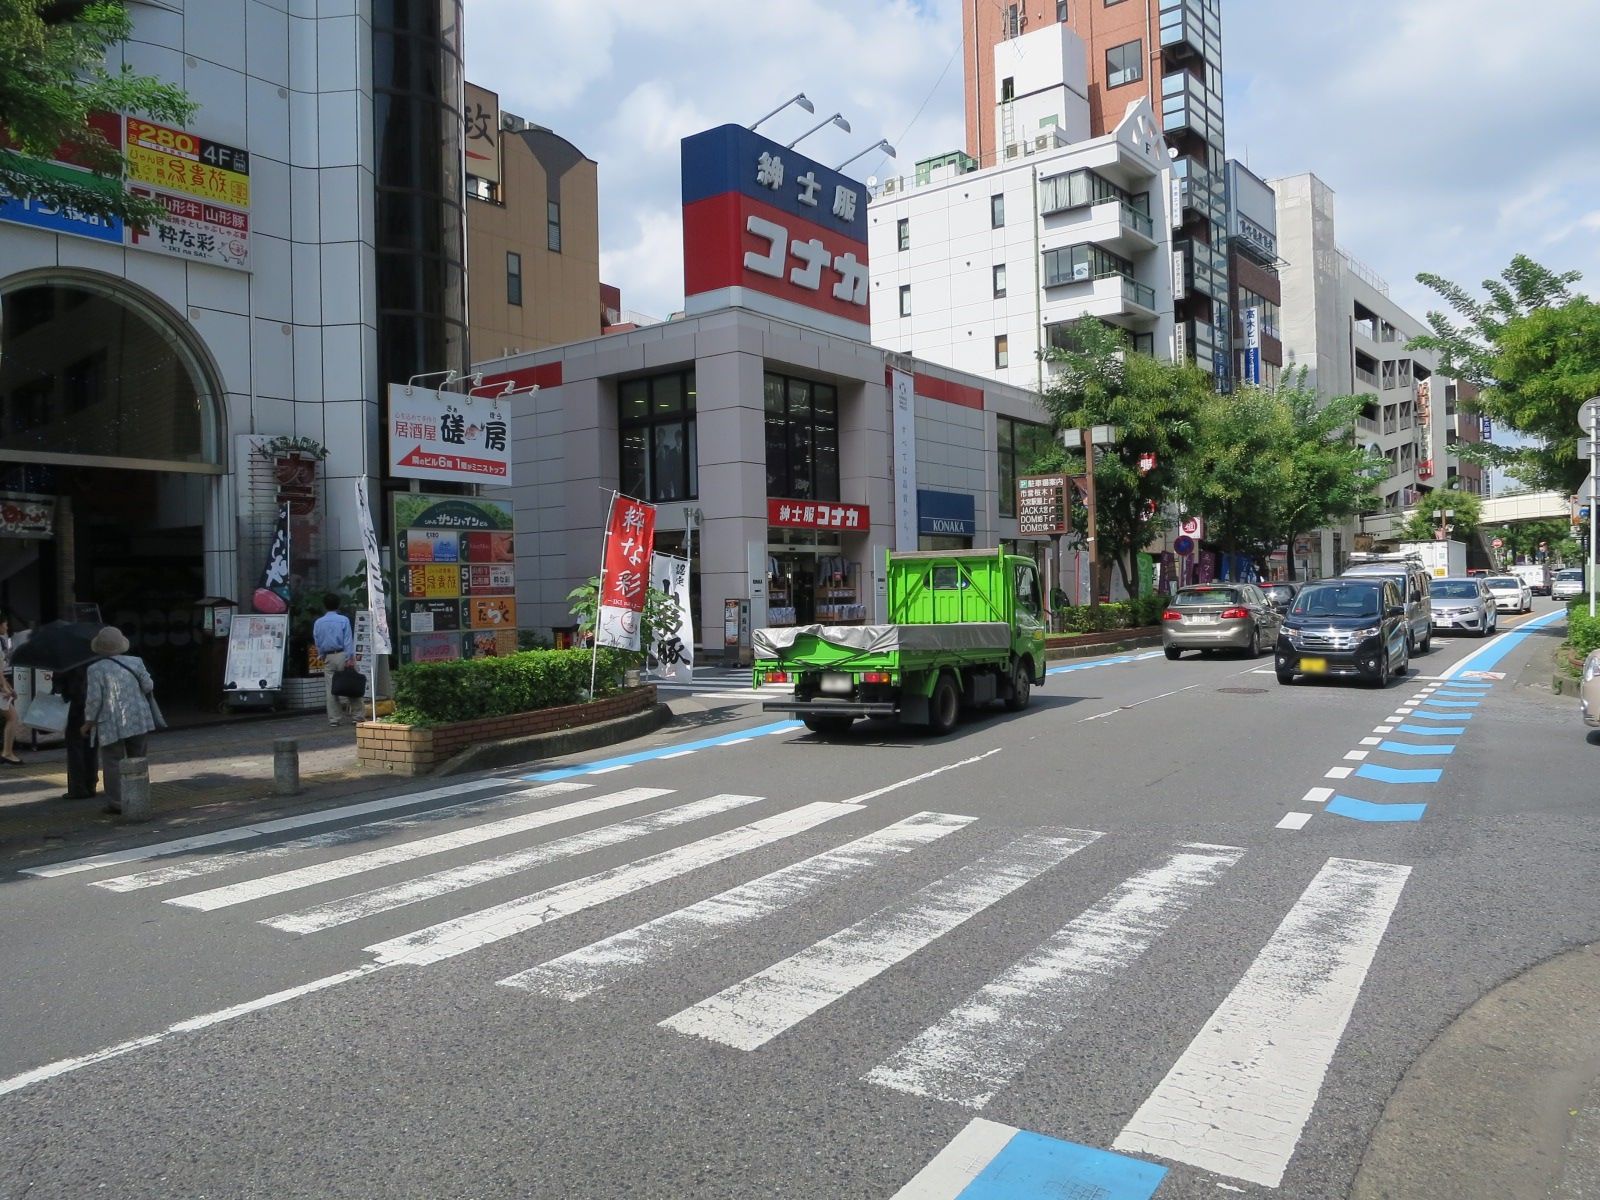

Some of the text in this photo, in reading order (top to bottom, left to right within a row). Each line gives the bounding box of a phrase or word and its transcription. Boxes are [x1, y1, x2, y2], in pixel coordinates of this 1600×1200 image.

[204, 145, 231, 166] 4F
[757, 151, 858, 222] 紳士服
[205, 208, 246, 229] 山形豚
[159, 225, 214, 252] 粋な彩
[743, 215, 869, 306] コナカ
[394, 420, 436, 441] 居酒屋
[779, 505, 859, 526] 紳士服 コナカ
[1020, 506, 1049, 515] JACK大宮
[933, 520, 965, 533] KONAKA
[614, 505, 646, 598] 粋な彩
